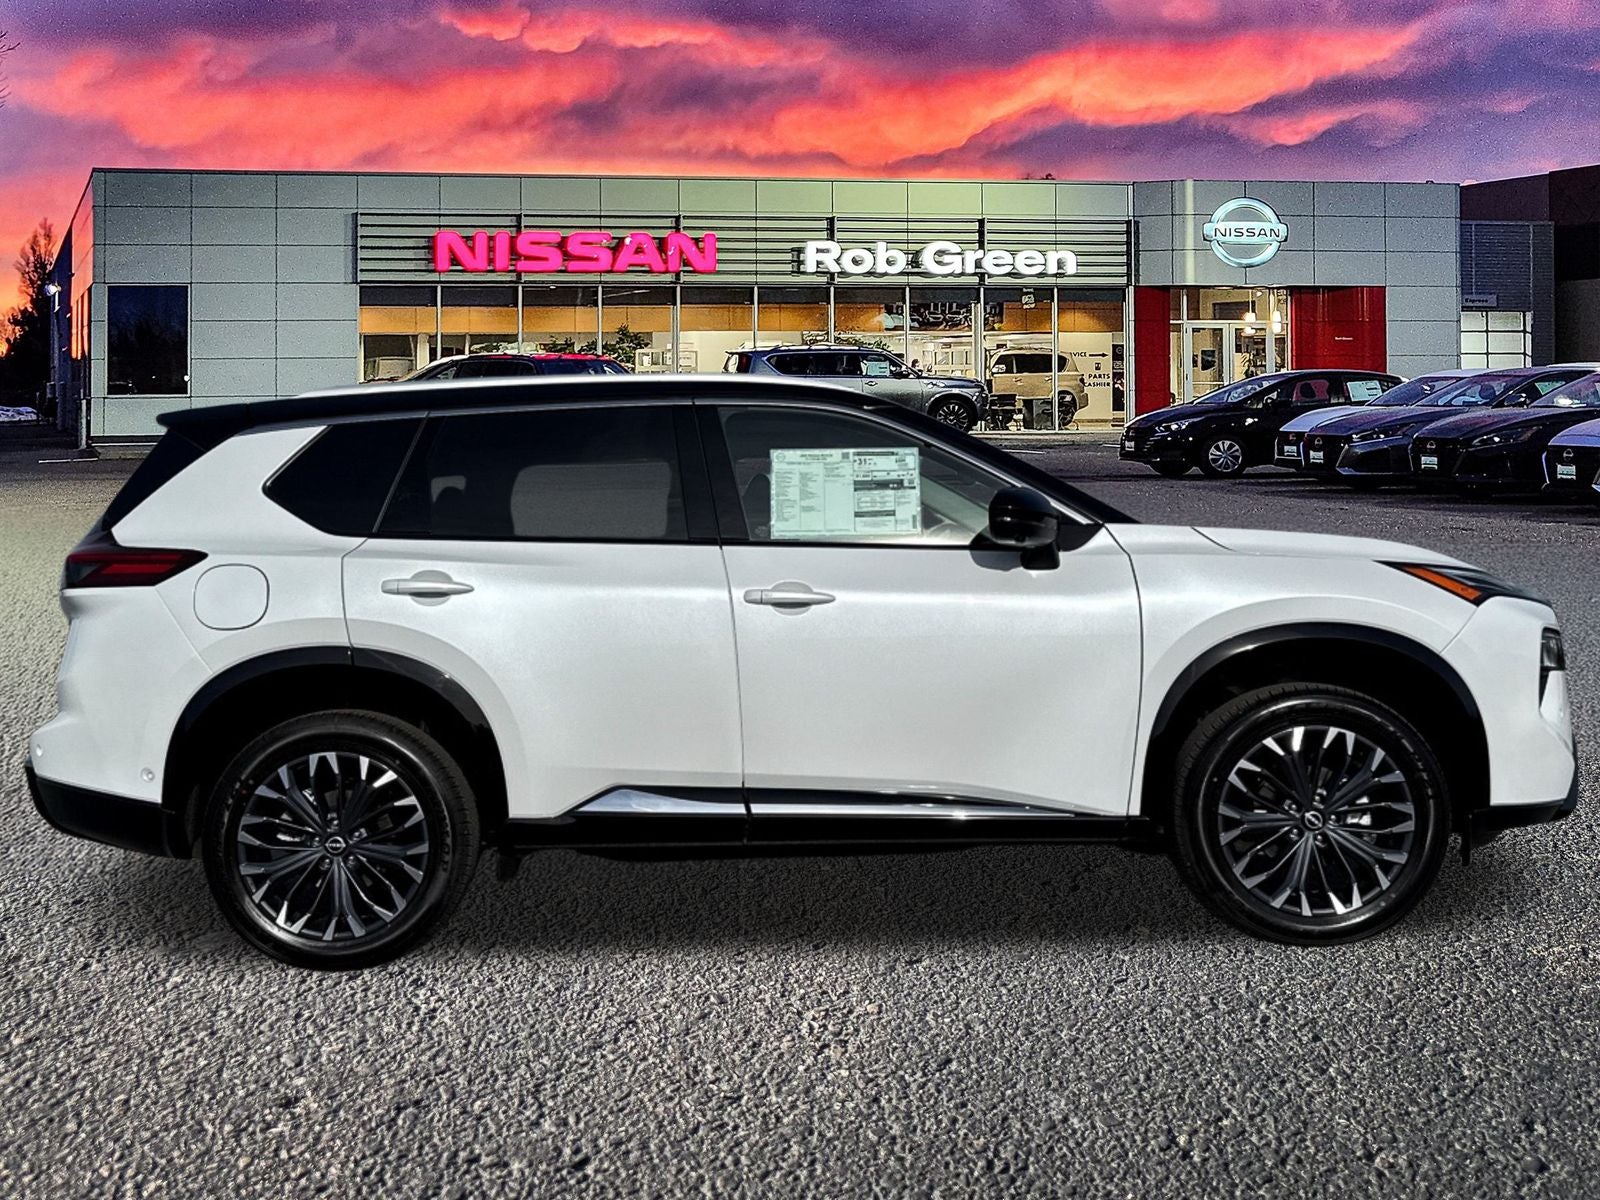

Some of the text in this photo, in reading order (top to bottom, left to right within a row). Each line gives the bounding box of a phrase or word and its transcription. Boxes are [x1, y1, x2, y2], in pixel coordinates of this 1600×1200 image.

[1214, 227, 1281, 238] NISSAN
[433, 230, 718, 273] NISSAN
[805, 240, 1078, 276] Rob Green
